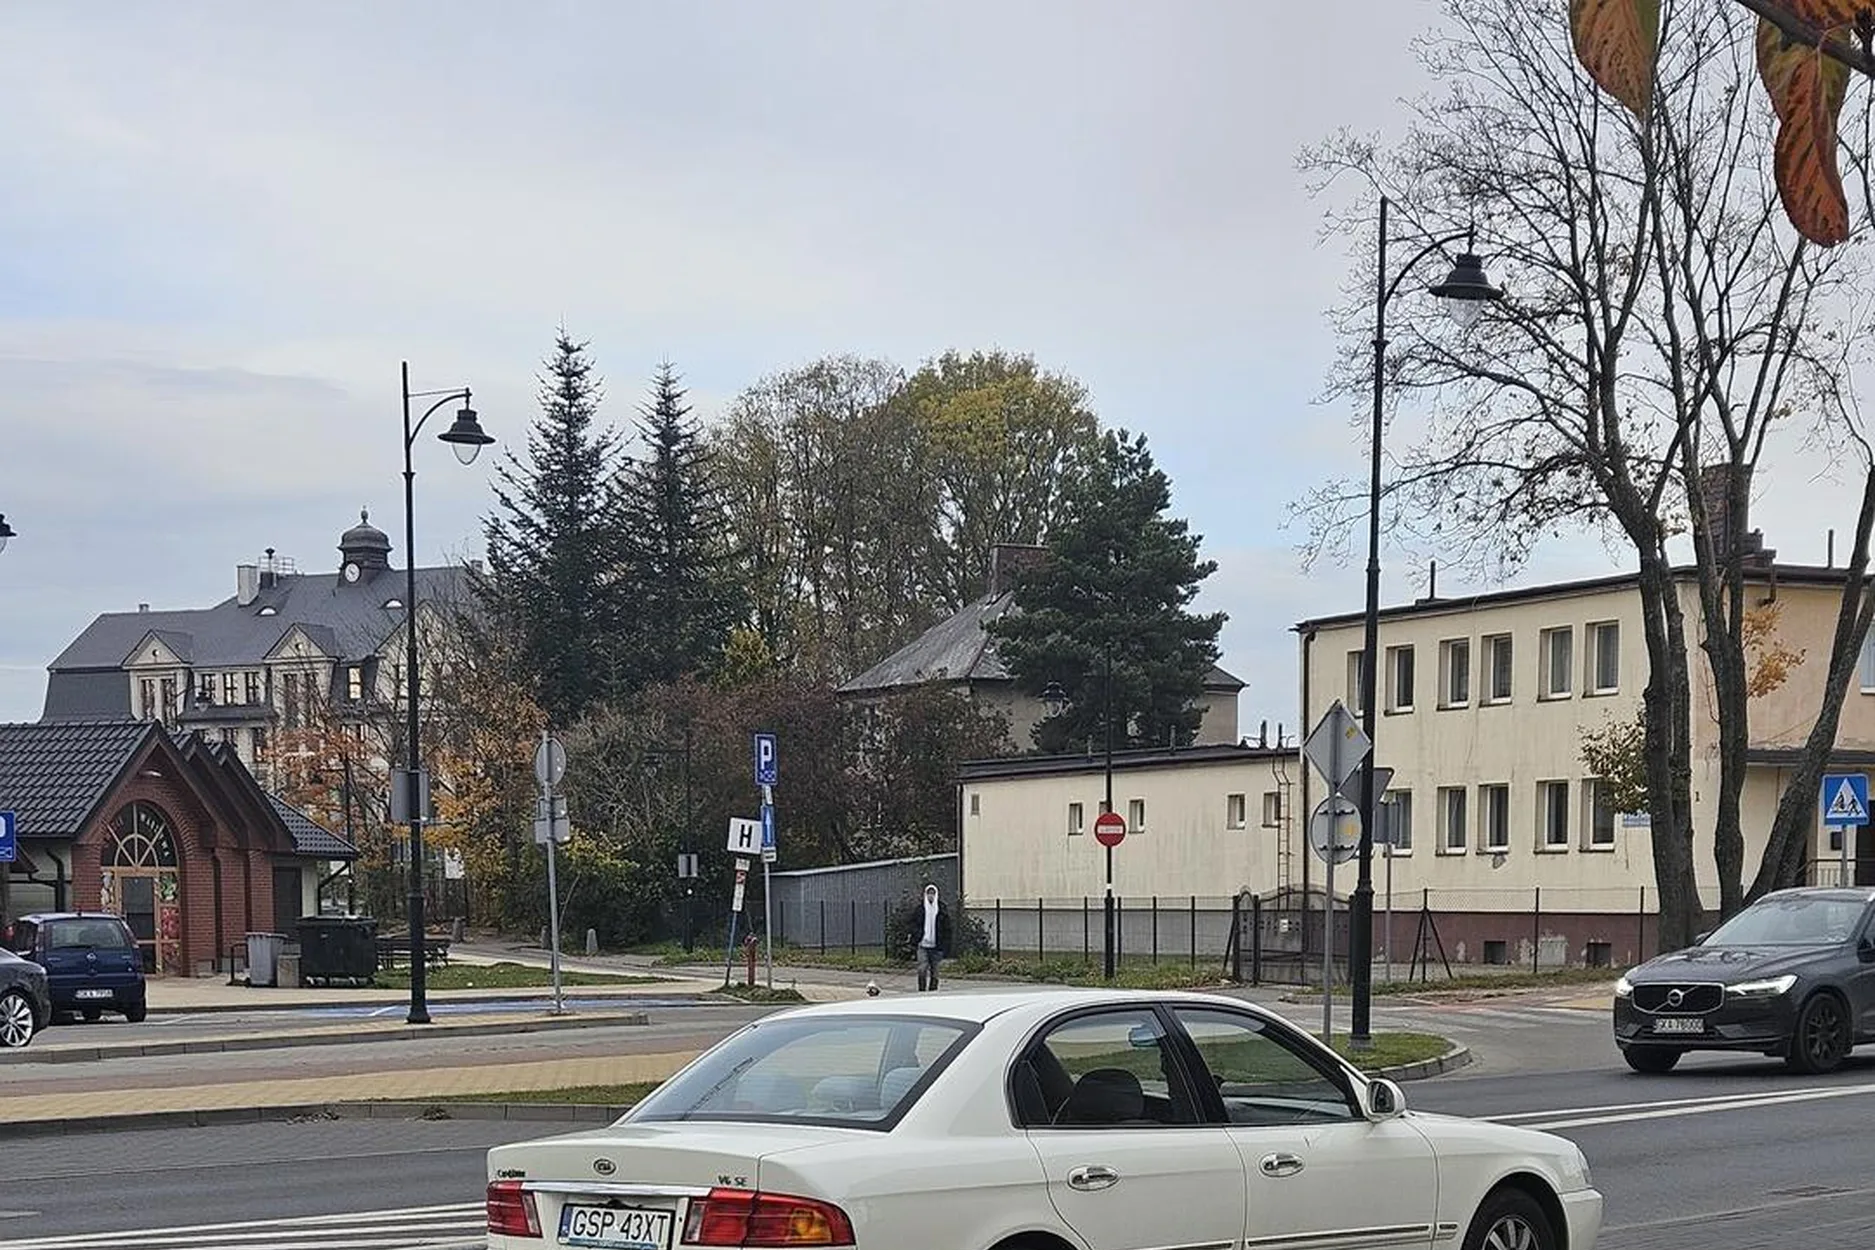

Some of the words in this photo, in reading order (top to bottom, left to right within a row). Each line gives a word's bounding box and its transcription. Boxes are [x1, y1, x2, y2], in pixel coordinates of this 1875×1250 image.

[760, 739, 772, 770] P
[739, 824, 753, 848] H
[573, 1210, 615, 1238] GSP
[620, 1213, 668, 1243] 43XT
